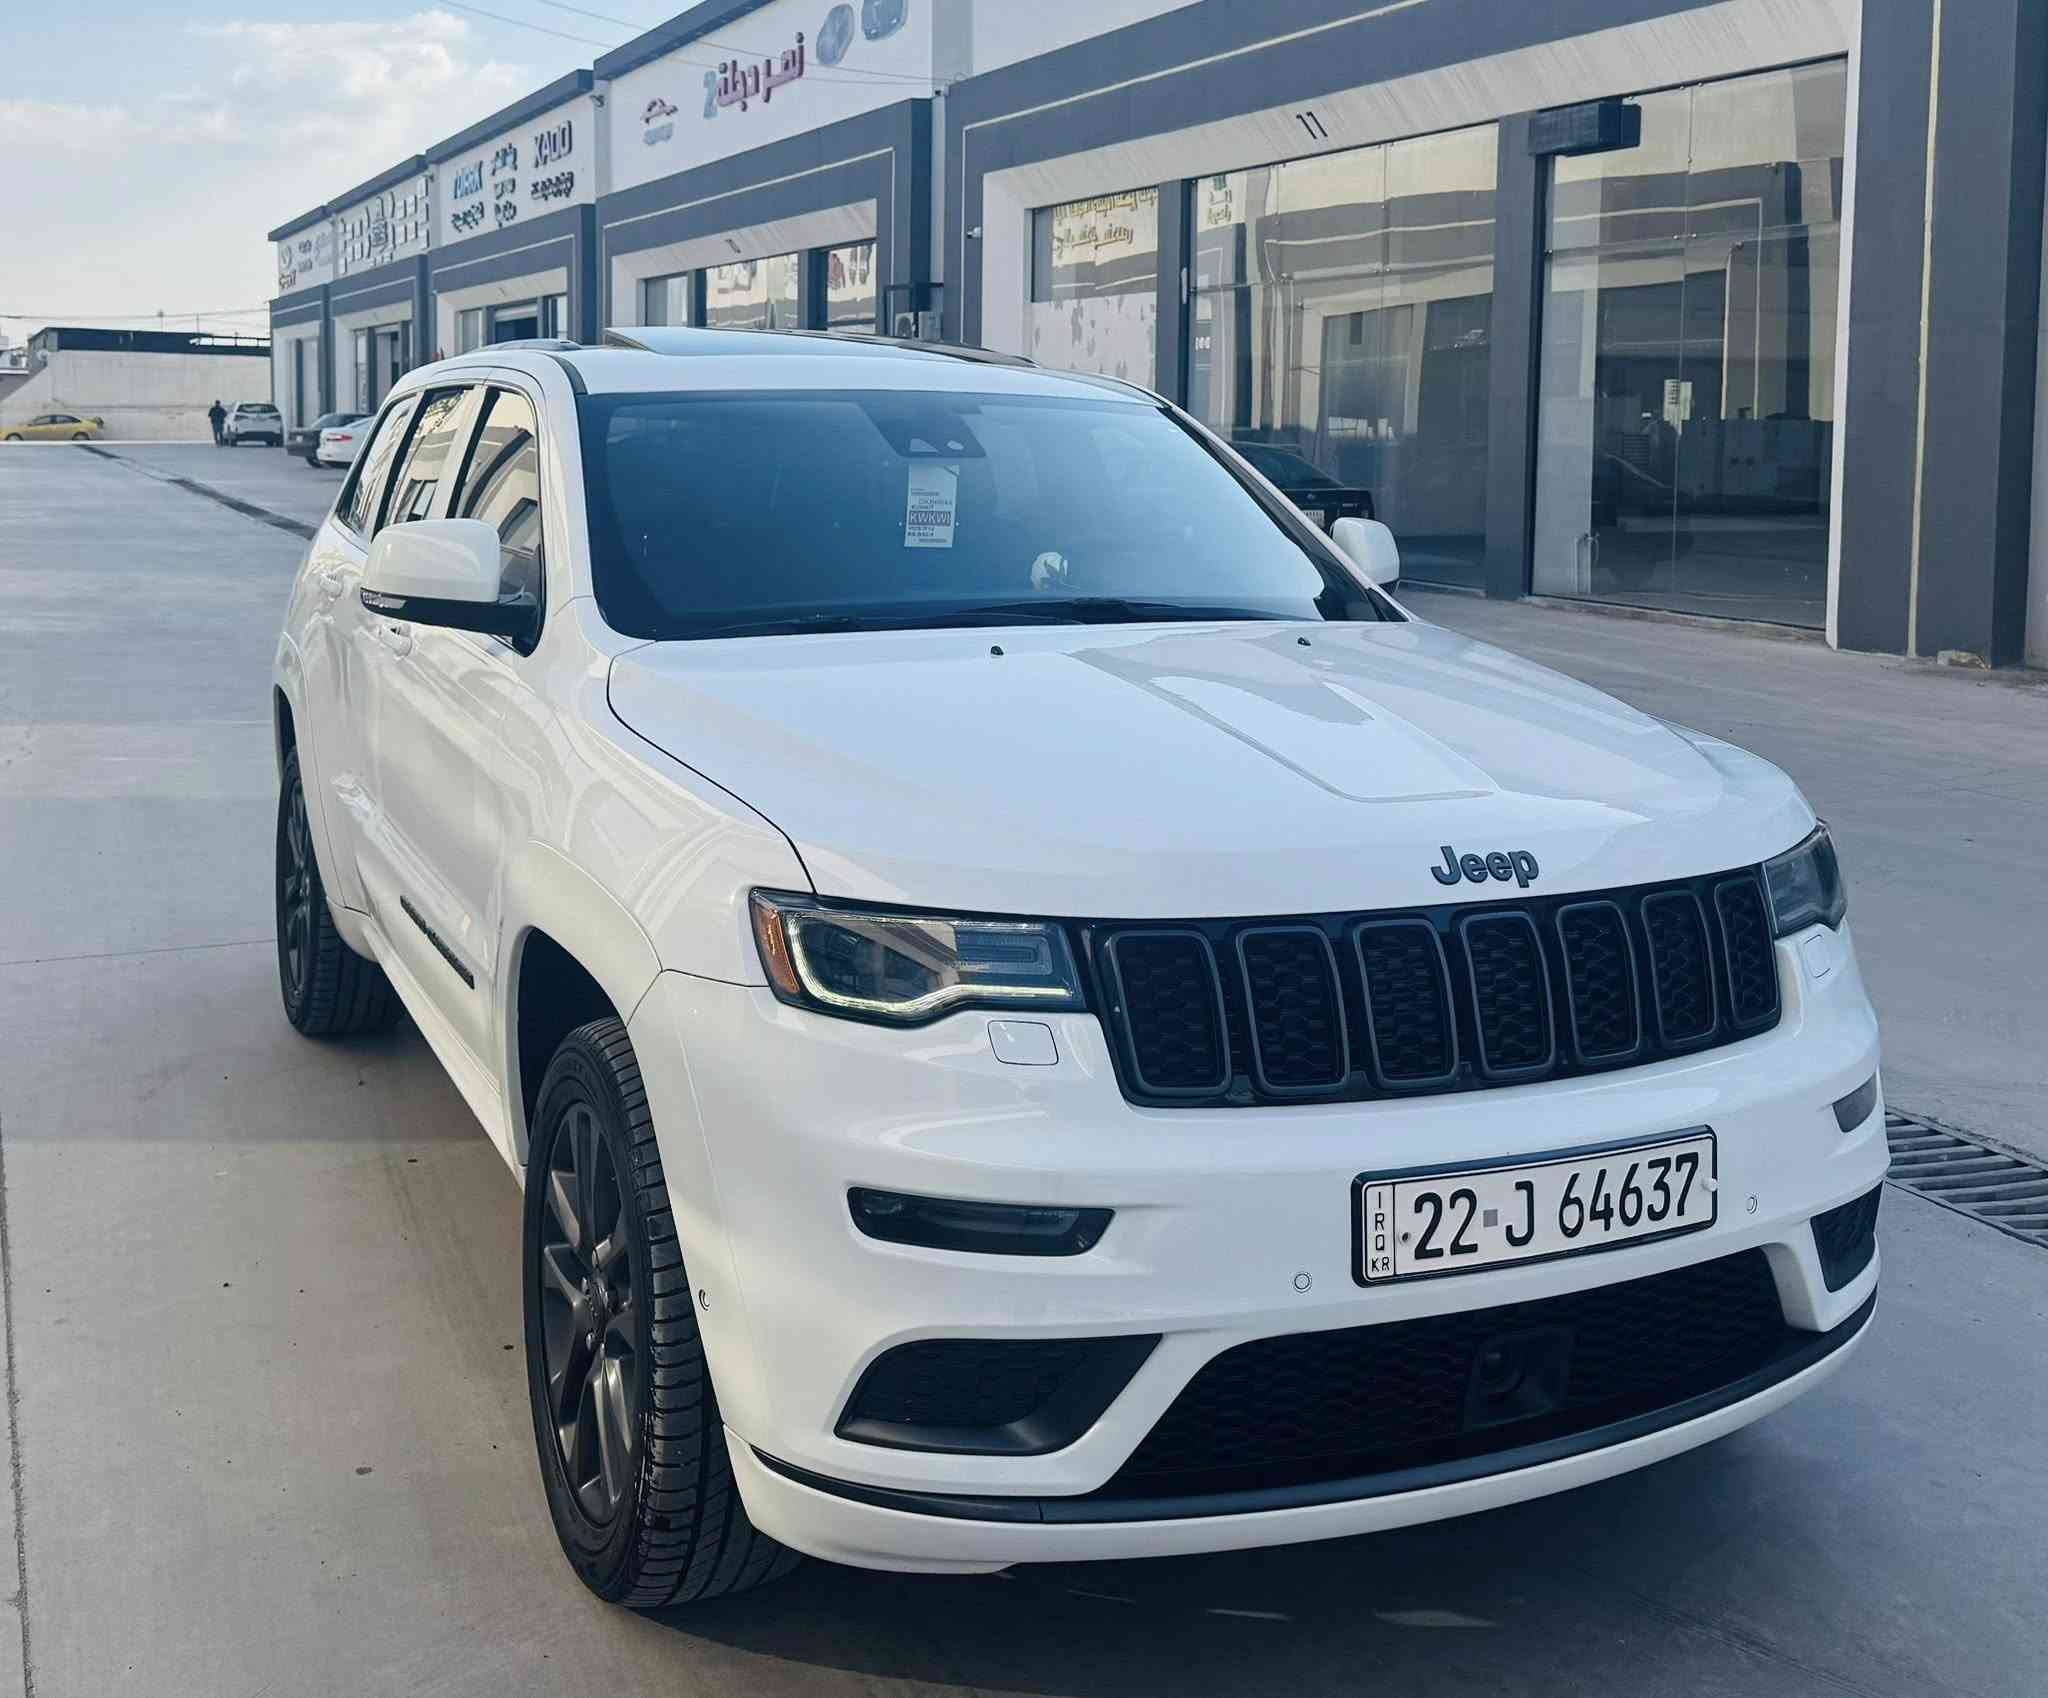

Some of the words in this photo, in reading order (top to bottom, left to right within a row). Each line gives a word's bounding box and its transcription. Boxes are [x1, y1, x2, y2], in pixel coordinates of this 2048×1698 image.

[1296, 111, 1328, 139] 11
[1430, 845, 1539, 888] Jeep
[1414, 1188, 1479, 1260] 22
[1505, 1180, 1535, 1246] J
[1558, 1151, 1700, 1238] 64637
[1371, 1256, 1390, 1273] KR
